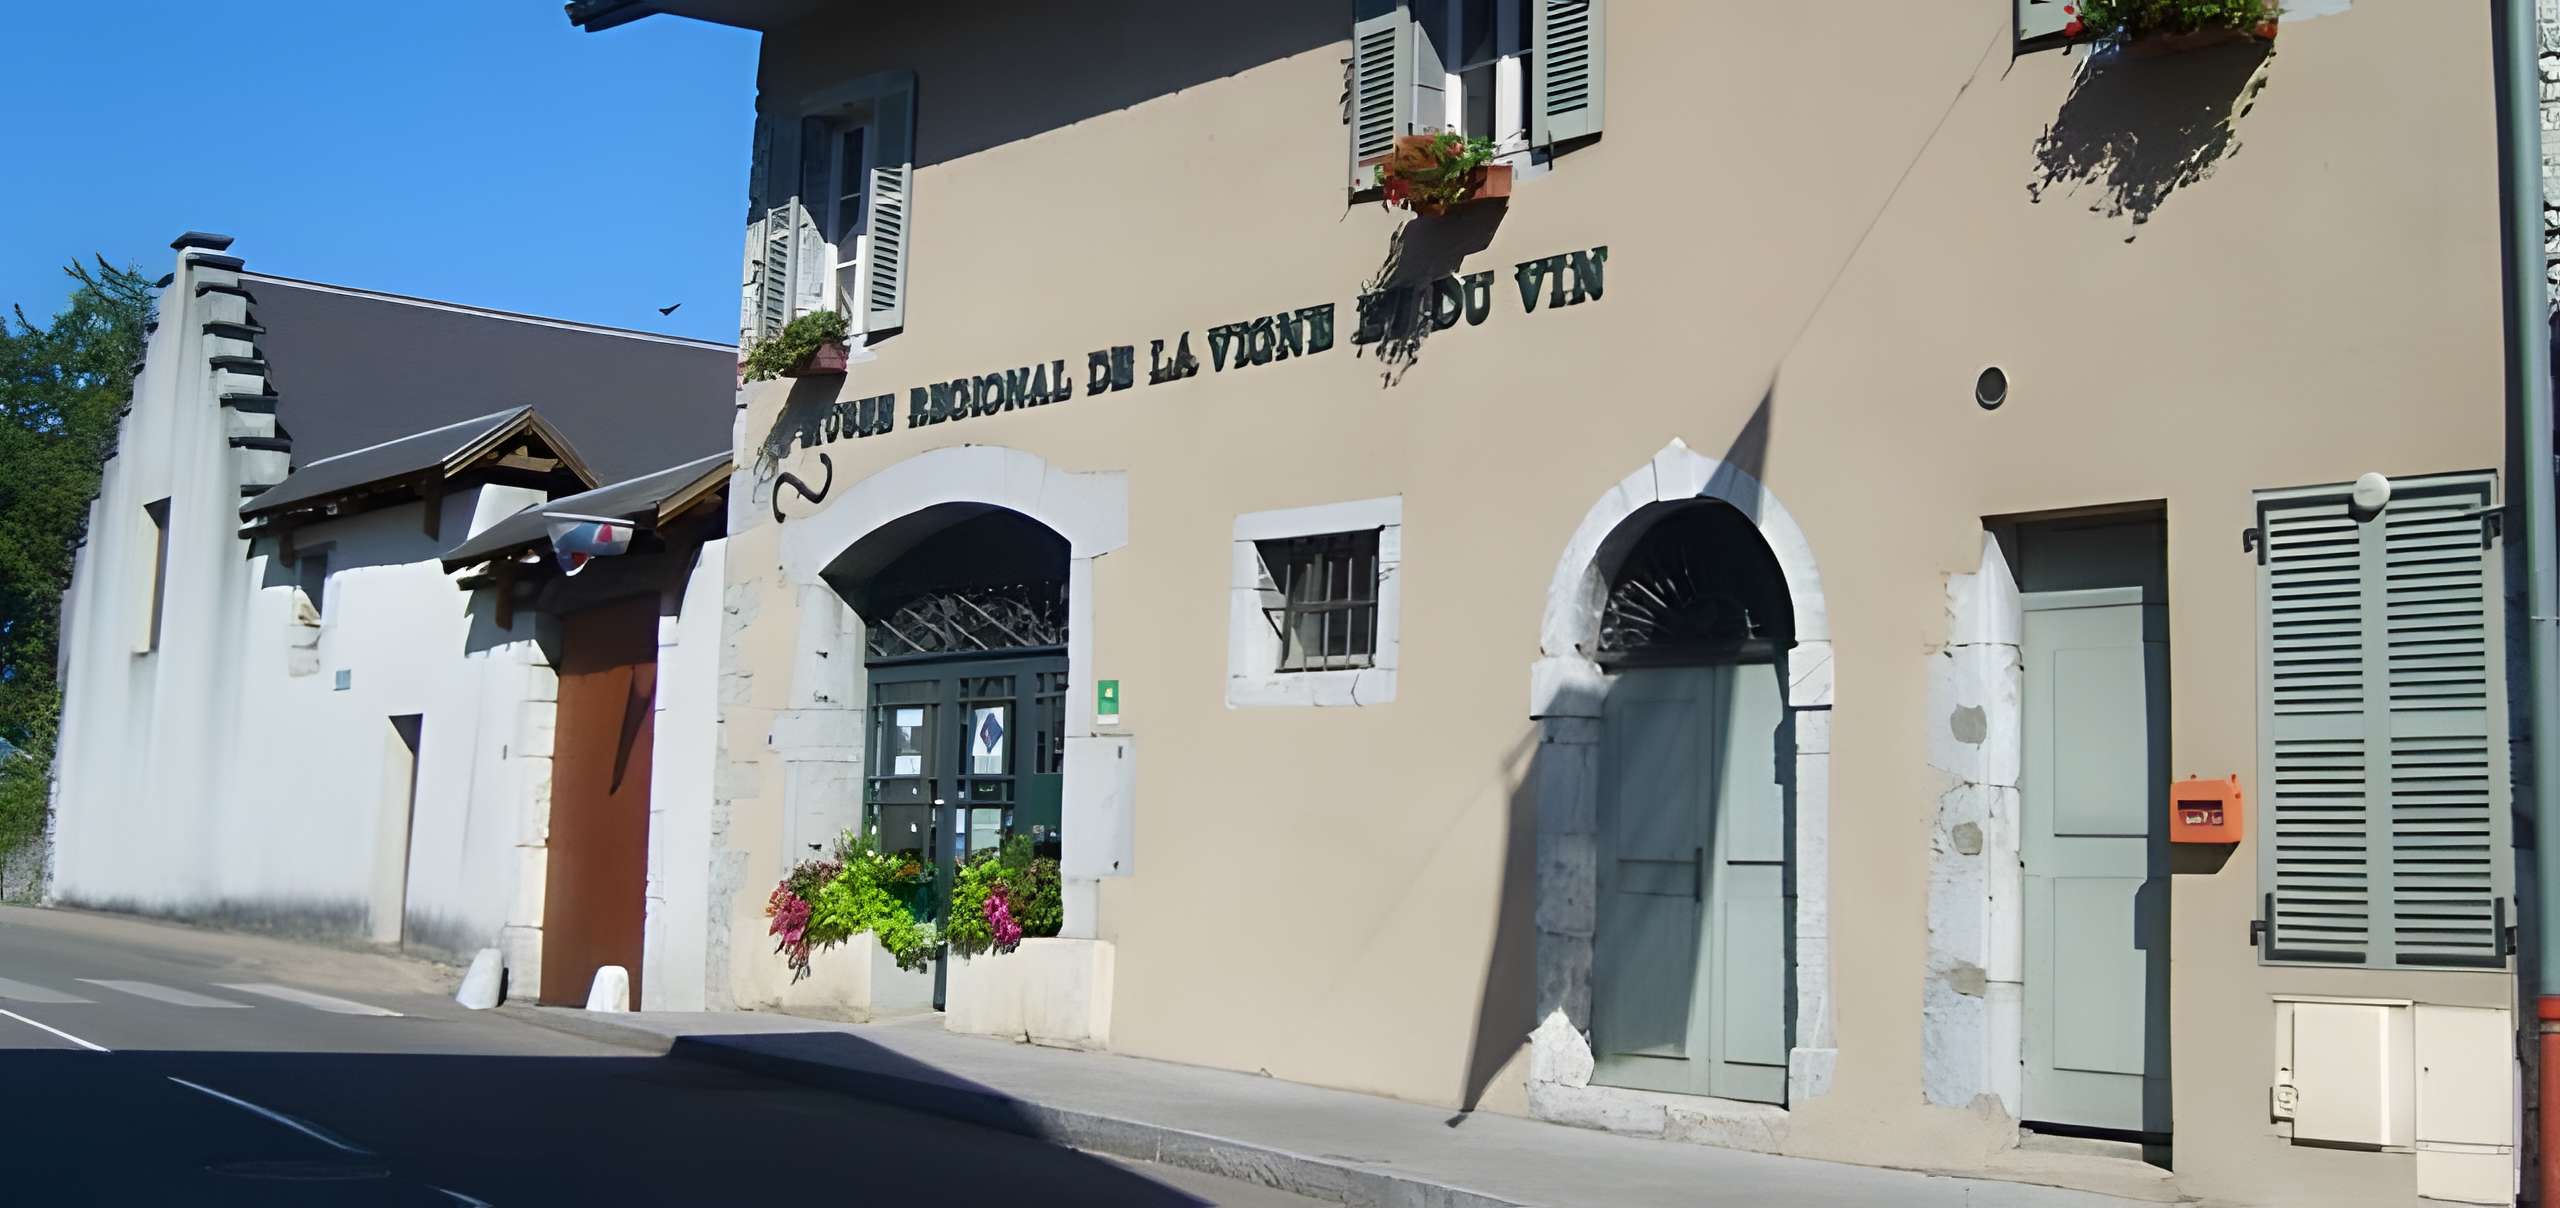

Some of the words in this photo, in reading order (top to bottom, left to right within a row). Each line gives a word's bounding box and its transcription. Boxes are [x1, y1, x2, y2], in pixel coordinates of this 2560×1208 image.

[908, 359, 1072, 429] REGIONAL
[1087, 345, 1135, 396] DE
[1149, 331, 1200, 385] LA
[1208, 303, 1336, 372] VIGNE
[1428, 270, 1495, 333] DU
[1514, 246, 1608, 314] VIN
